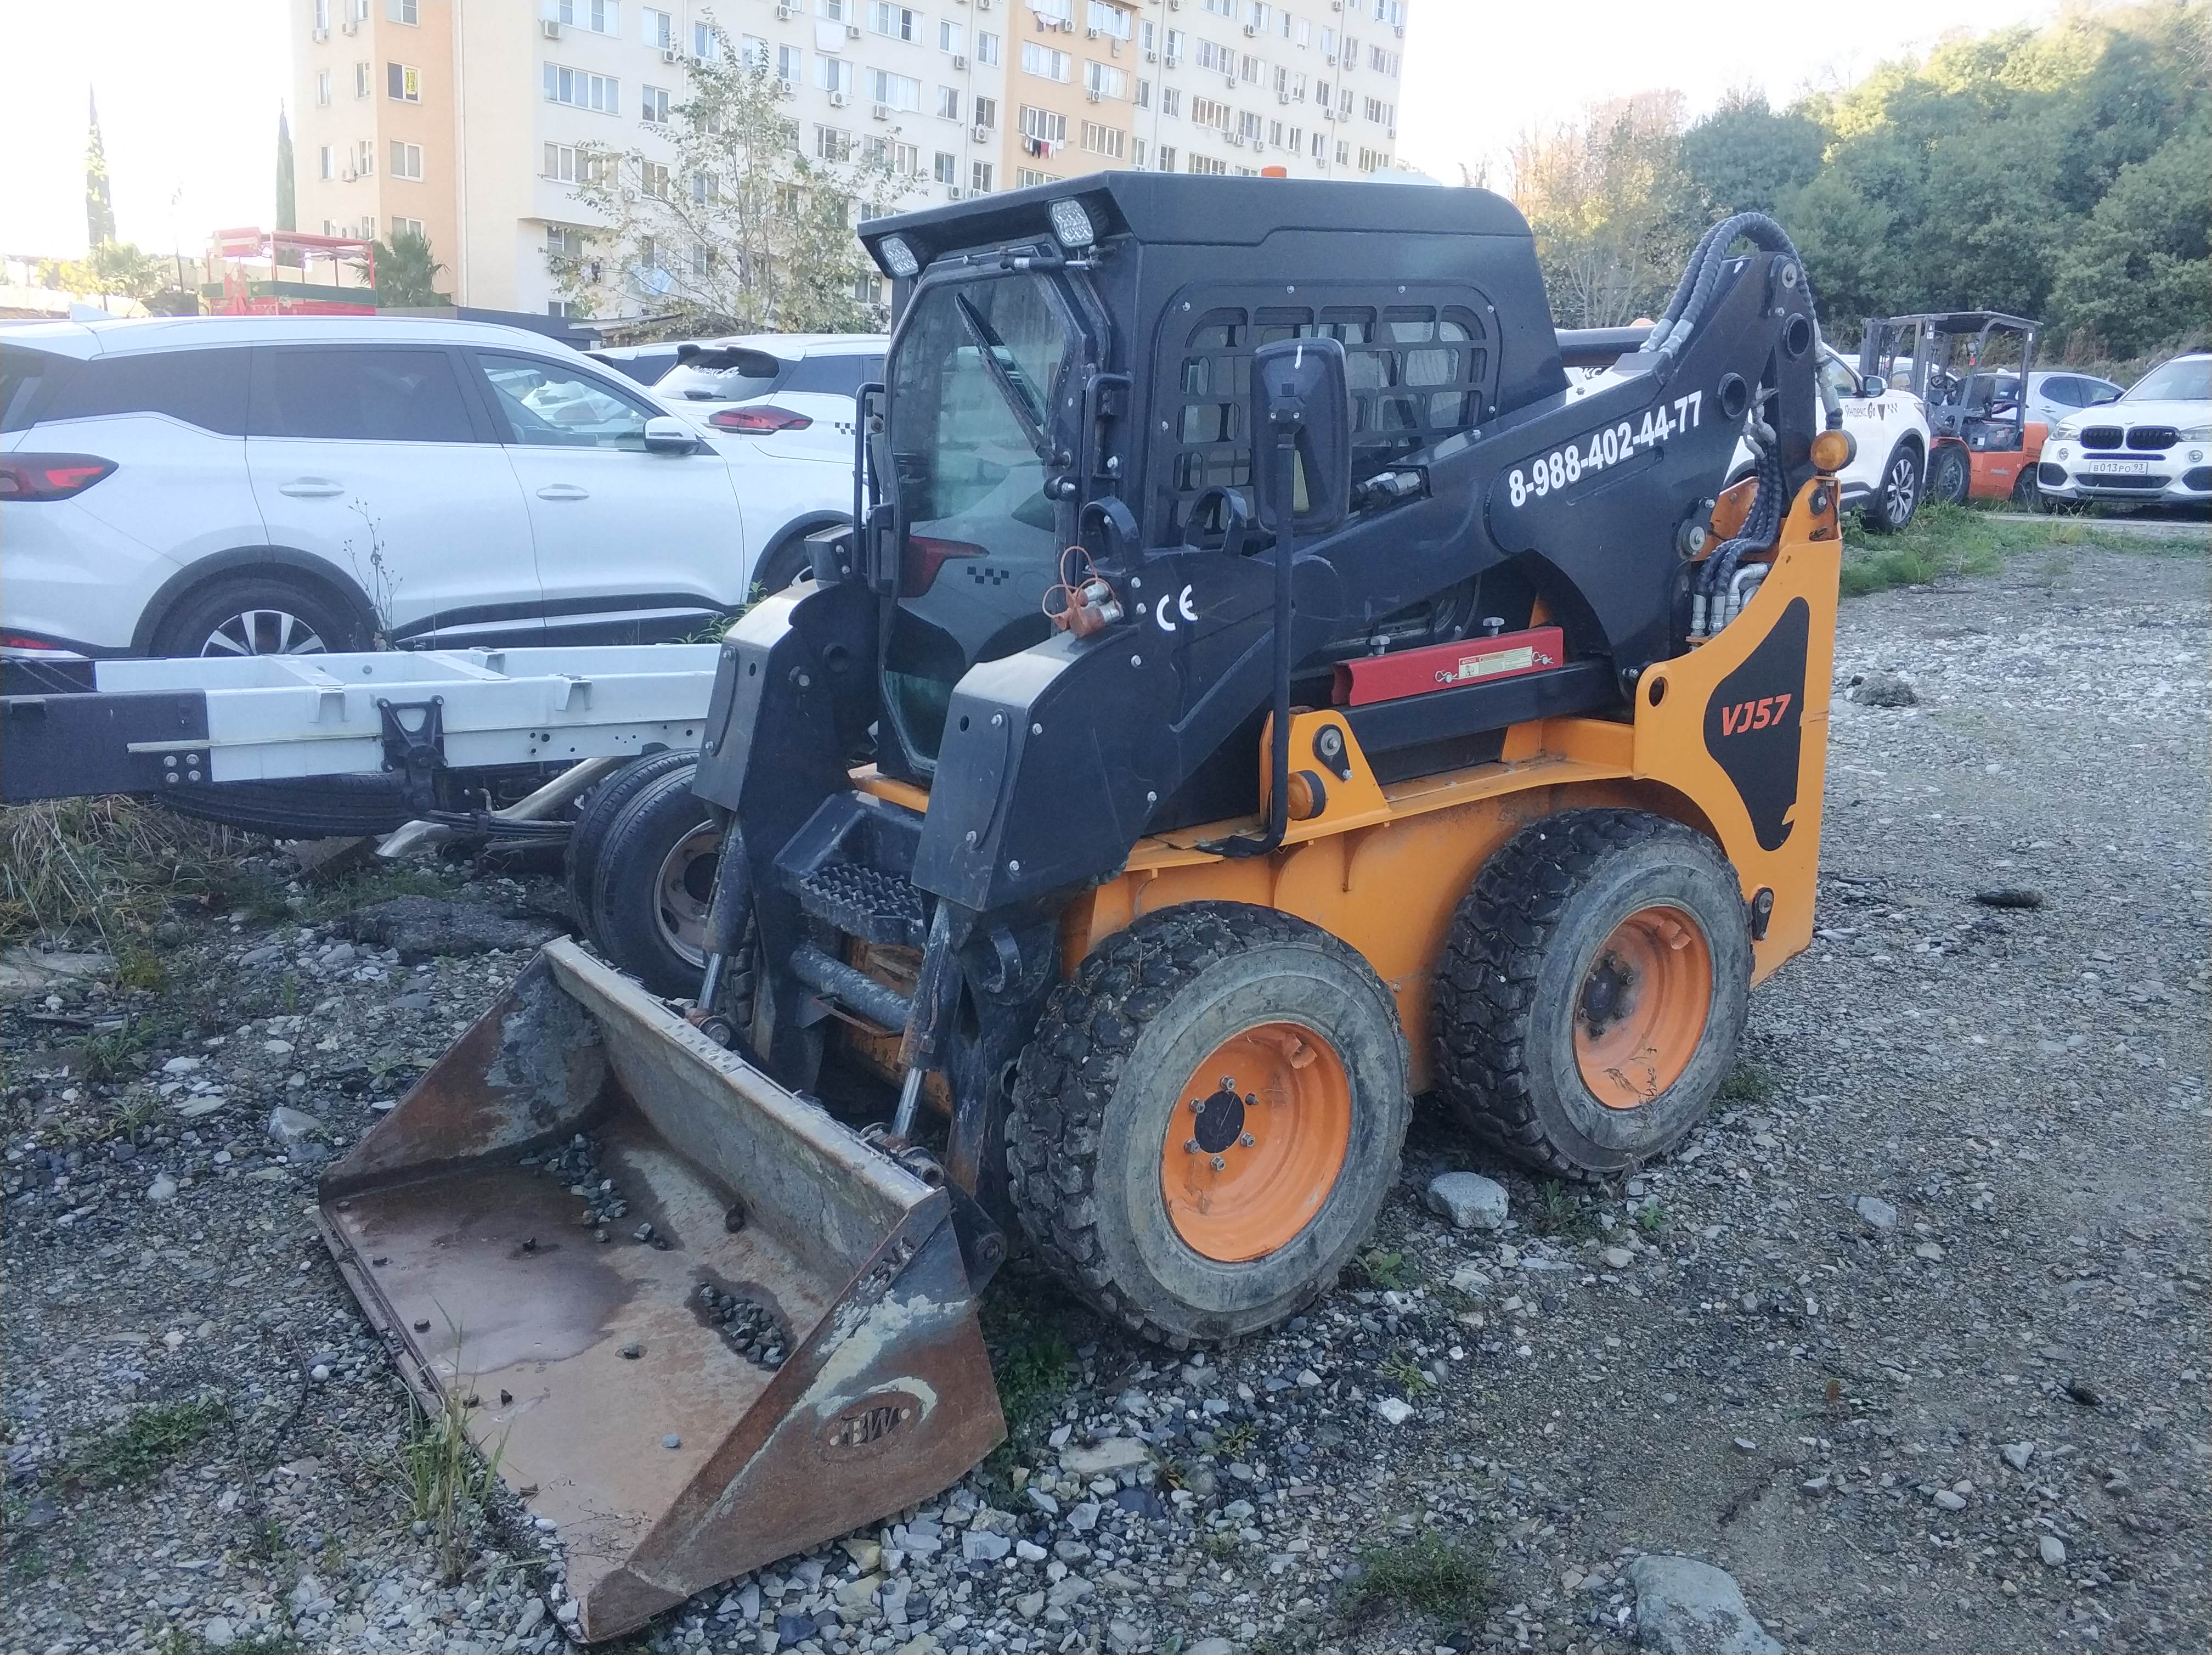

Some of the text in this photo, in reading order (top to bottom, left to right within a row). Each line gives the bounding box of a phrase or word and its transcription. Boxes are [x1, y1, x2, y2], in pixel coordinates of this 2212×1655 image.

[1867, 402, 1876, 419] Go
[1509, 390, 1701, 506] 8-988-402-44-77
[1156, 584, 1198, 632] CE
[1722, 693, 1792, 736] VJ57
